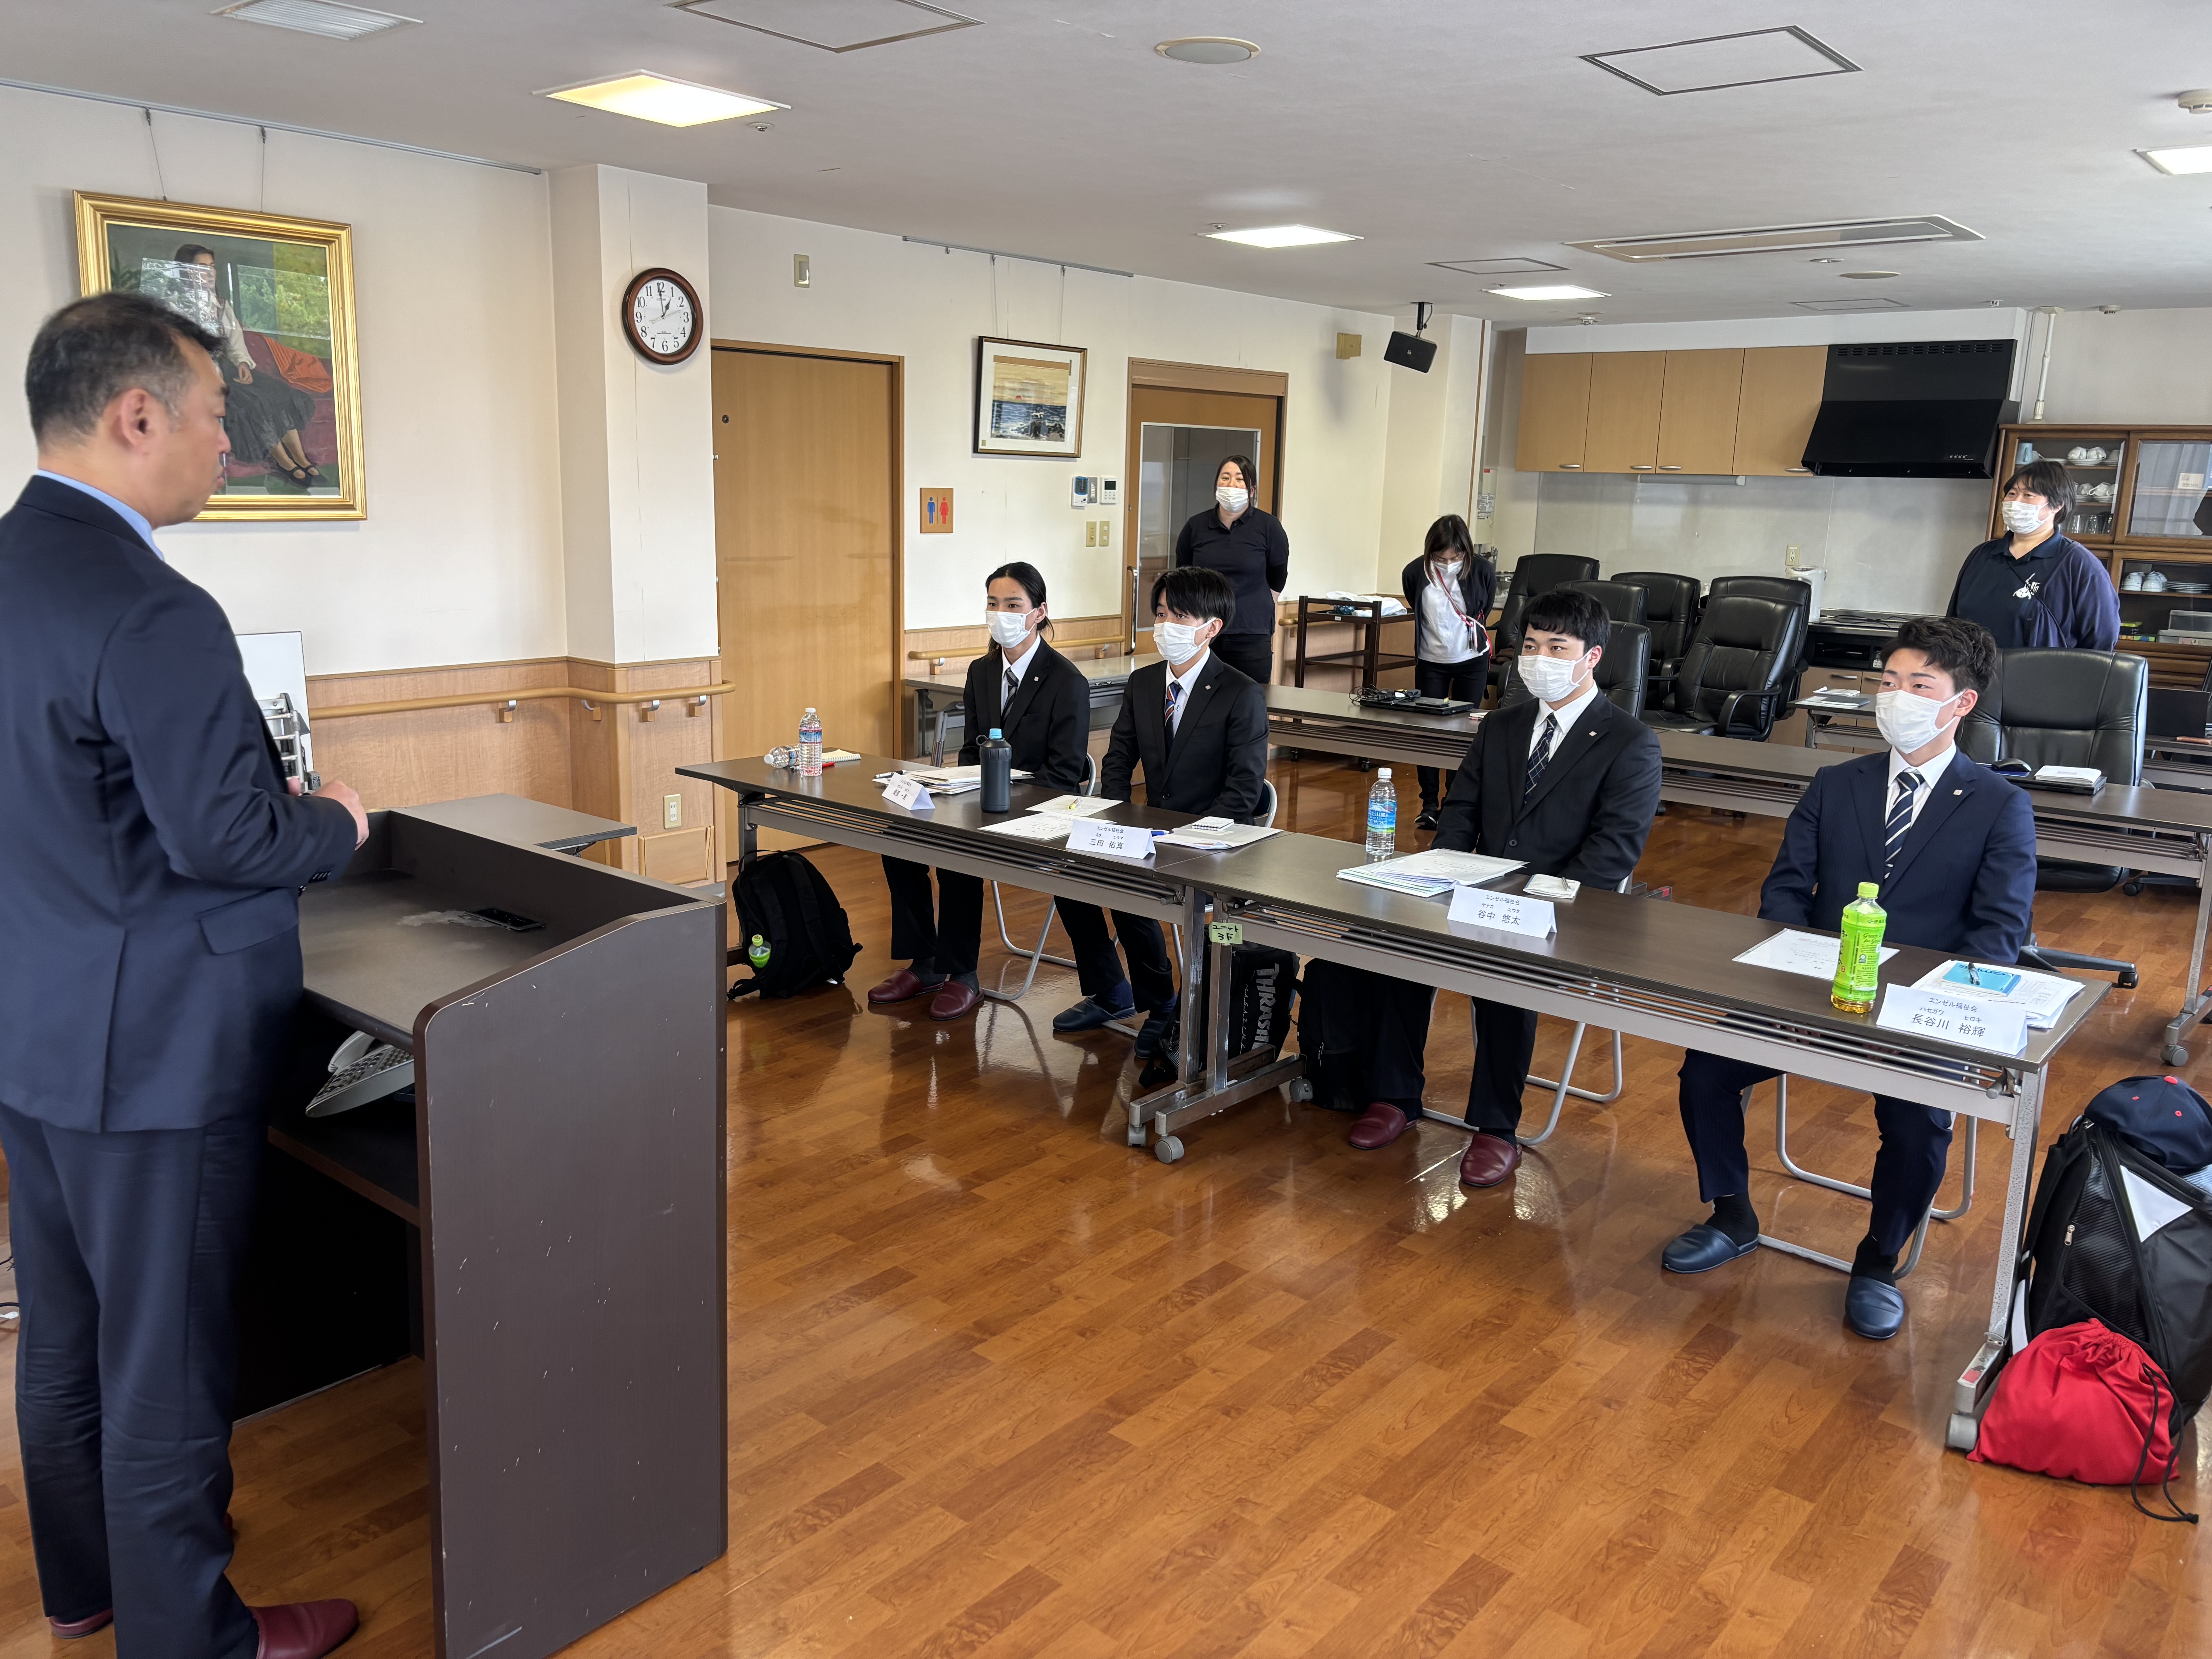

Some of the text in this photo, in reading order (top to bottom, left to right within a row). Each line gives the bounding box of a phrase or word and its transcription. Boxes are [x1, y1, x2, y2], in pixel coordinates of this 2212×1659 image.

[646, 286, 652, 297] 11
[656, 282, 665, 293] 12
[671, 287, 674, 297] 1
[637, 296, 646, 308] 10
[678, 296, 684, 307] 2
[635, 311, 642, 323] 9
[684, 312, 689, 323] 3
[641, 326, 647, 337] 8
[680, 326, 687, 337] 4
[650, 337, 656, 348] 7
[662, 340, 668, 352] 6
[673, 337, 679, 348] 5
[1109, 841, 1124, 850] 佑真
[1486, 895, 1520, 905] エンゼル福祉会
[1477, 910, 1521, 925] 谷中 悠太
[1212, 925, 1239, 933] ユニット
[1218, 933, 1233, 941] 3F
[1929, 998, 1978, 1012] エンゼル福祉会
[1919, 1007, 1944, 1015] ハセガワ
[1911, 1013, 1986, 1037] 長谷川 裕輝
